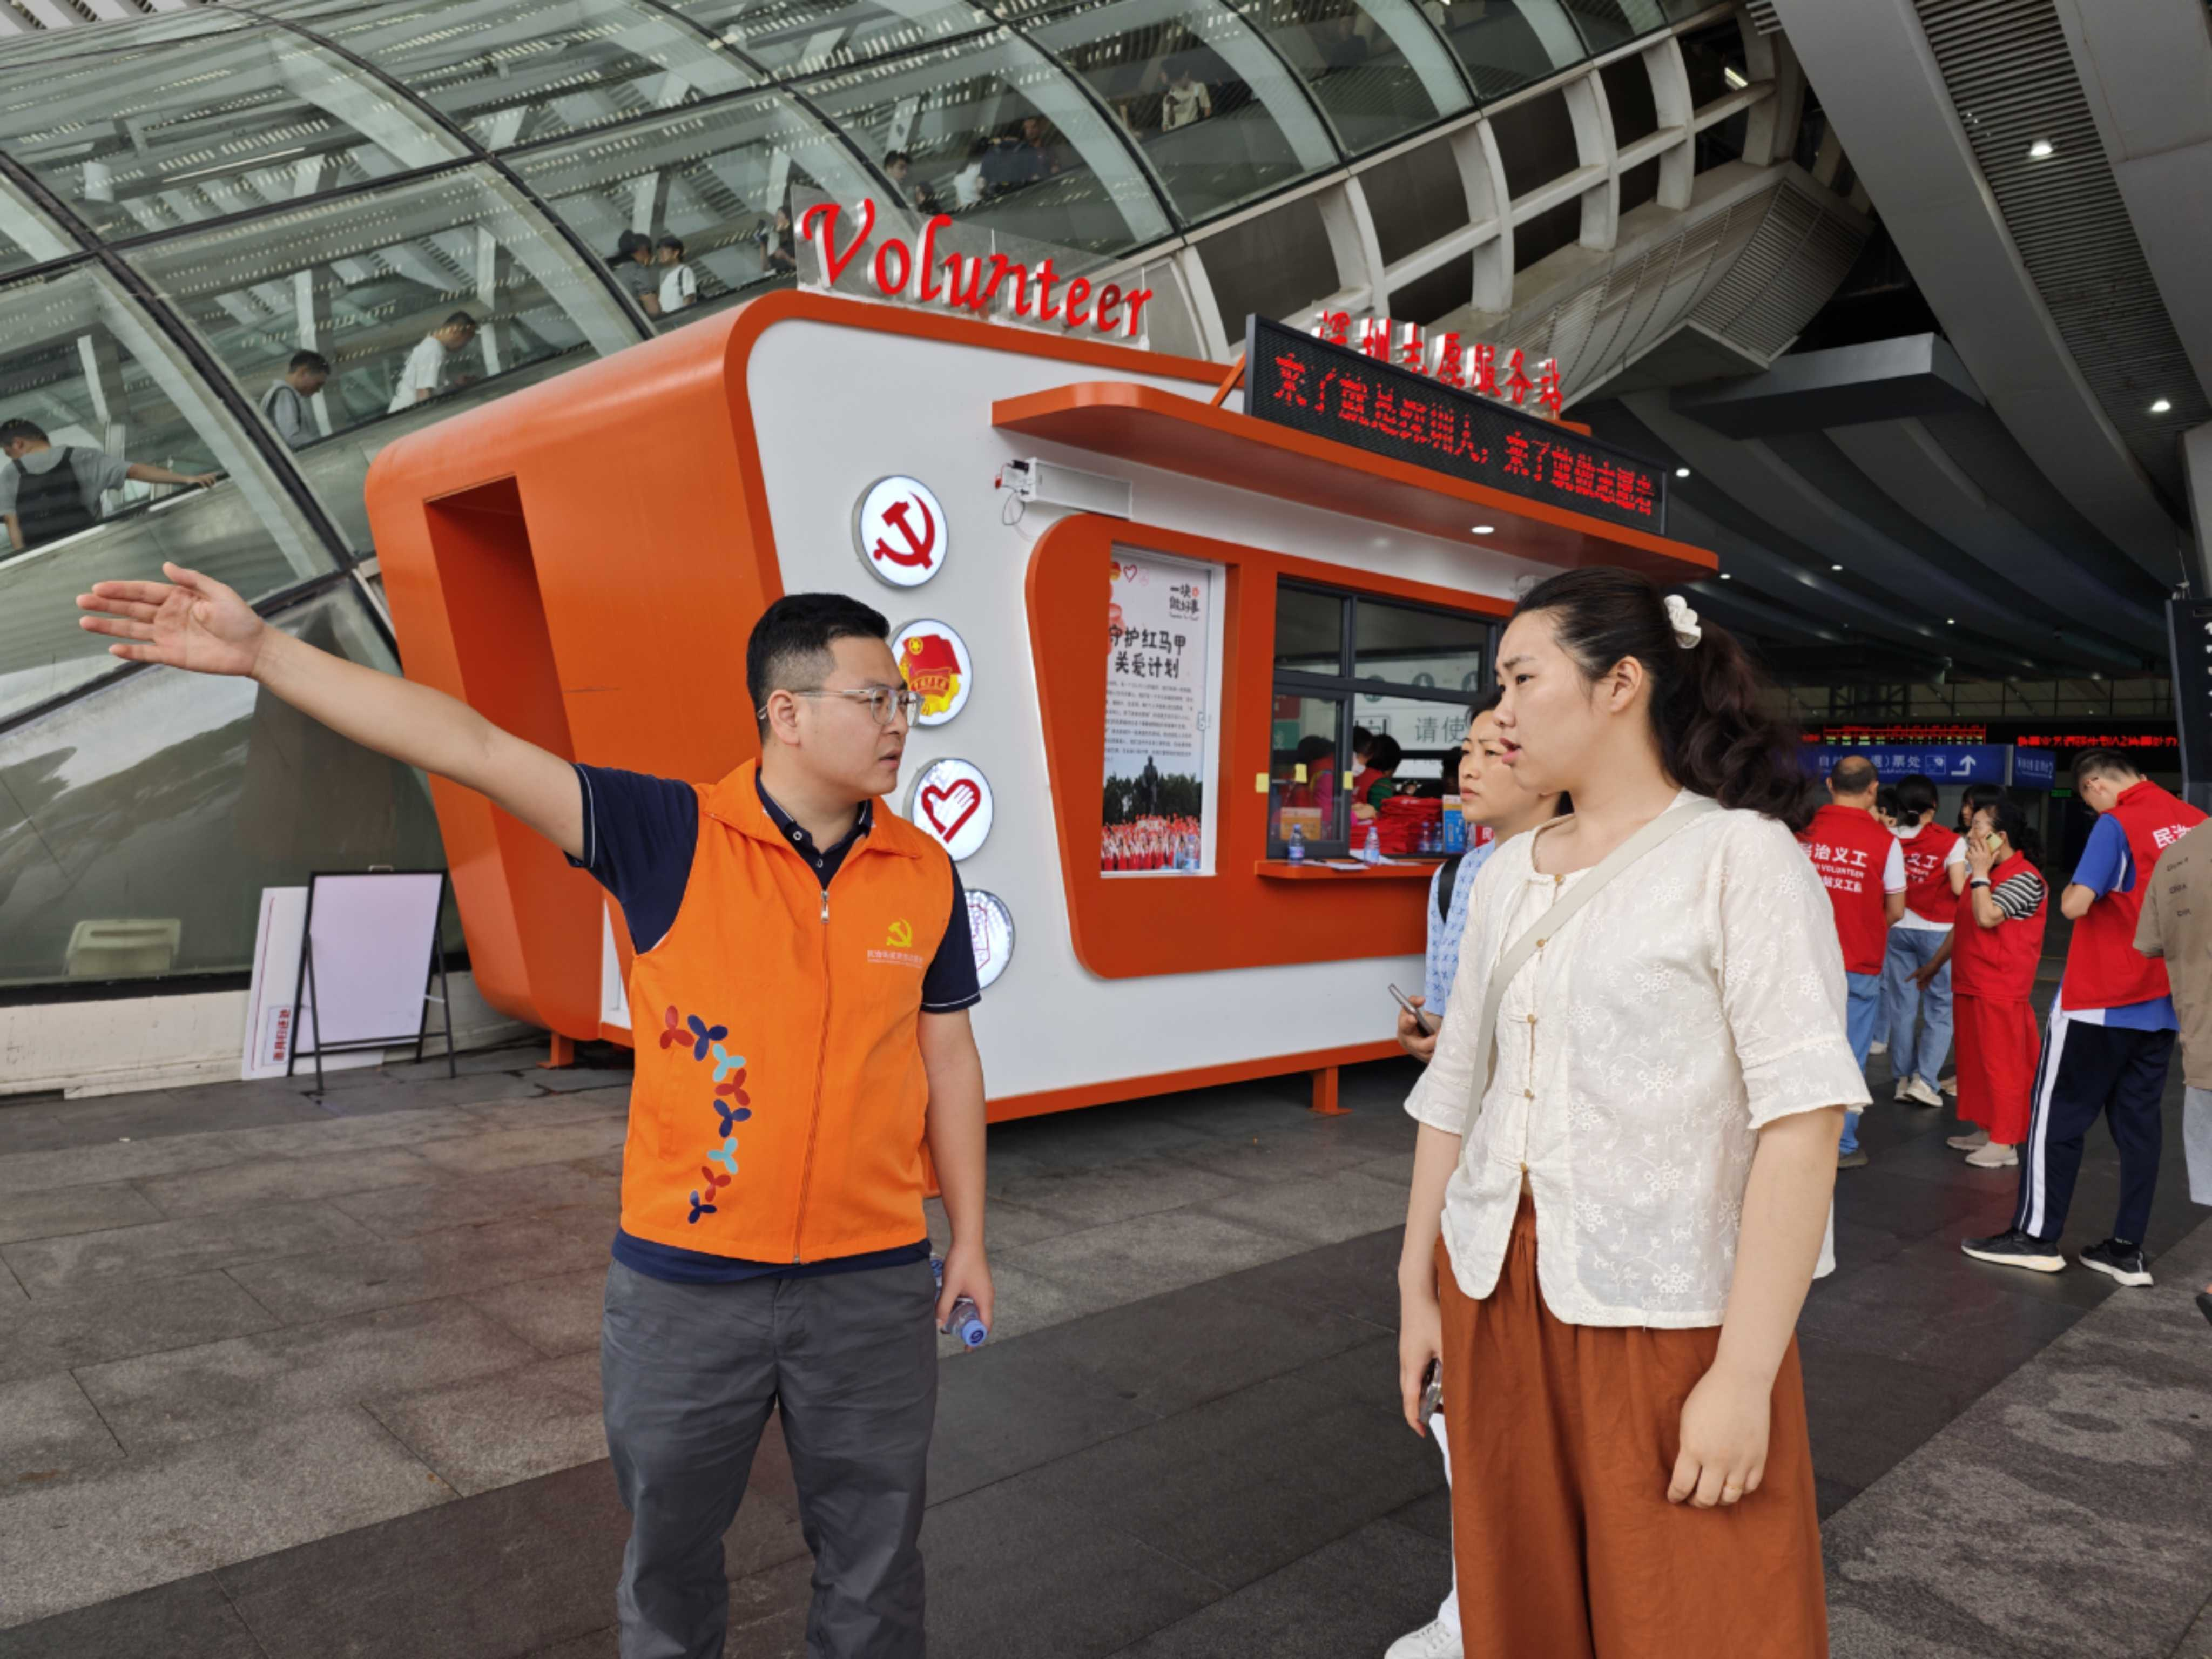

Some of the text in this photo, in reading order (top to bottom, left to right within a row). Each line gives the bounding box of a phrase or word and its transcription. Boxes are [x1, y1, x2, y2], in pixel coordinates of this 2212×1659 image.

[801, 198, 1152, 337] Volunteer
[1109, 624, 1186, 655] 守护红马甲
[1115, 651, 1179, 679] 关爱计划
